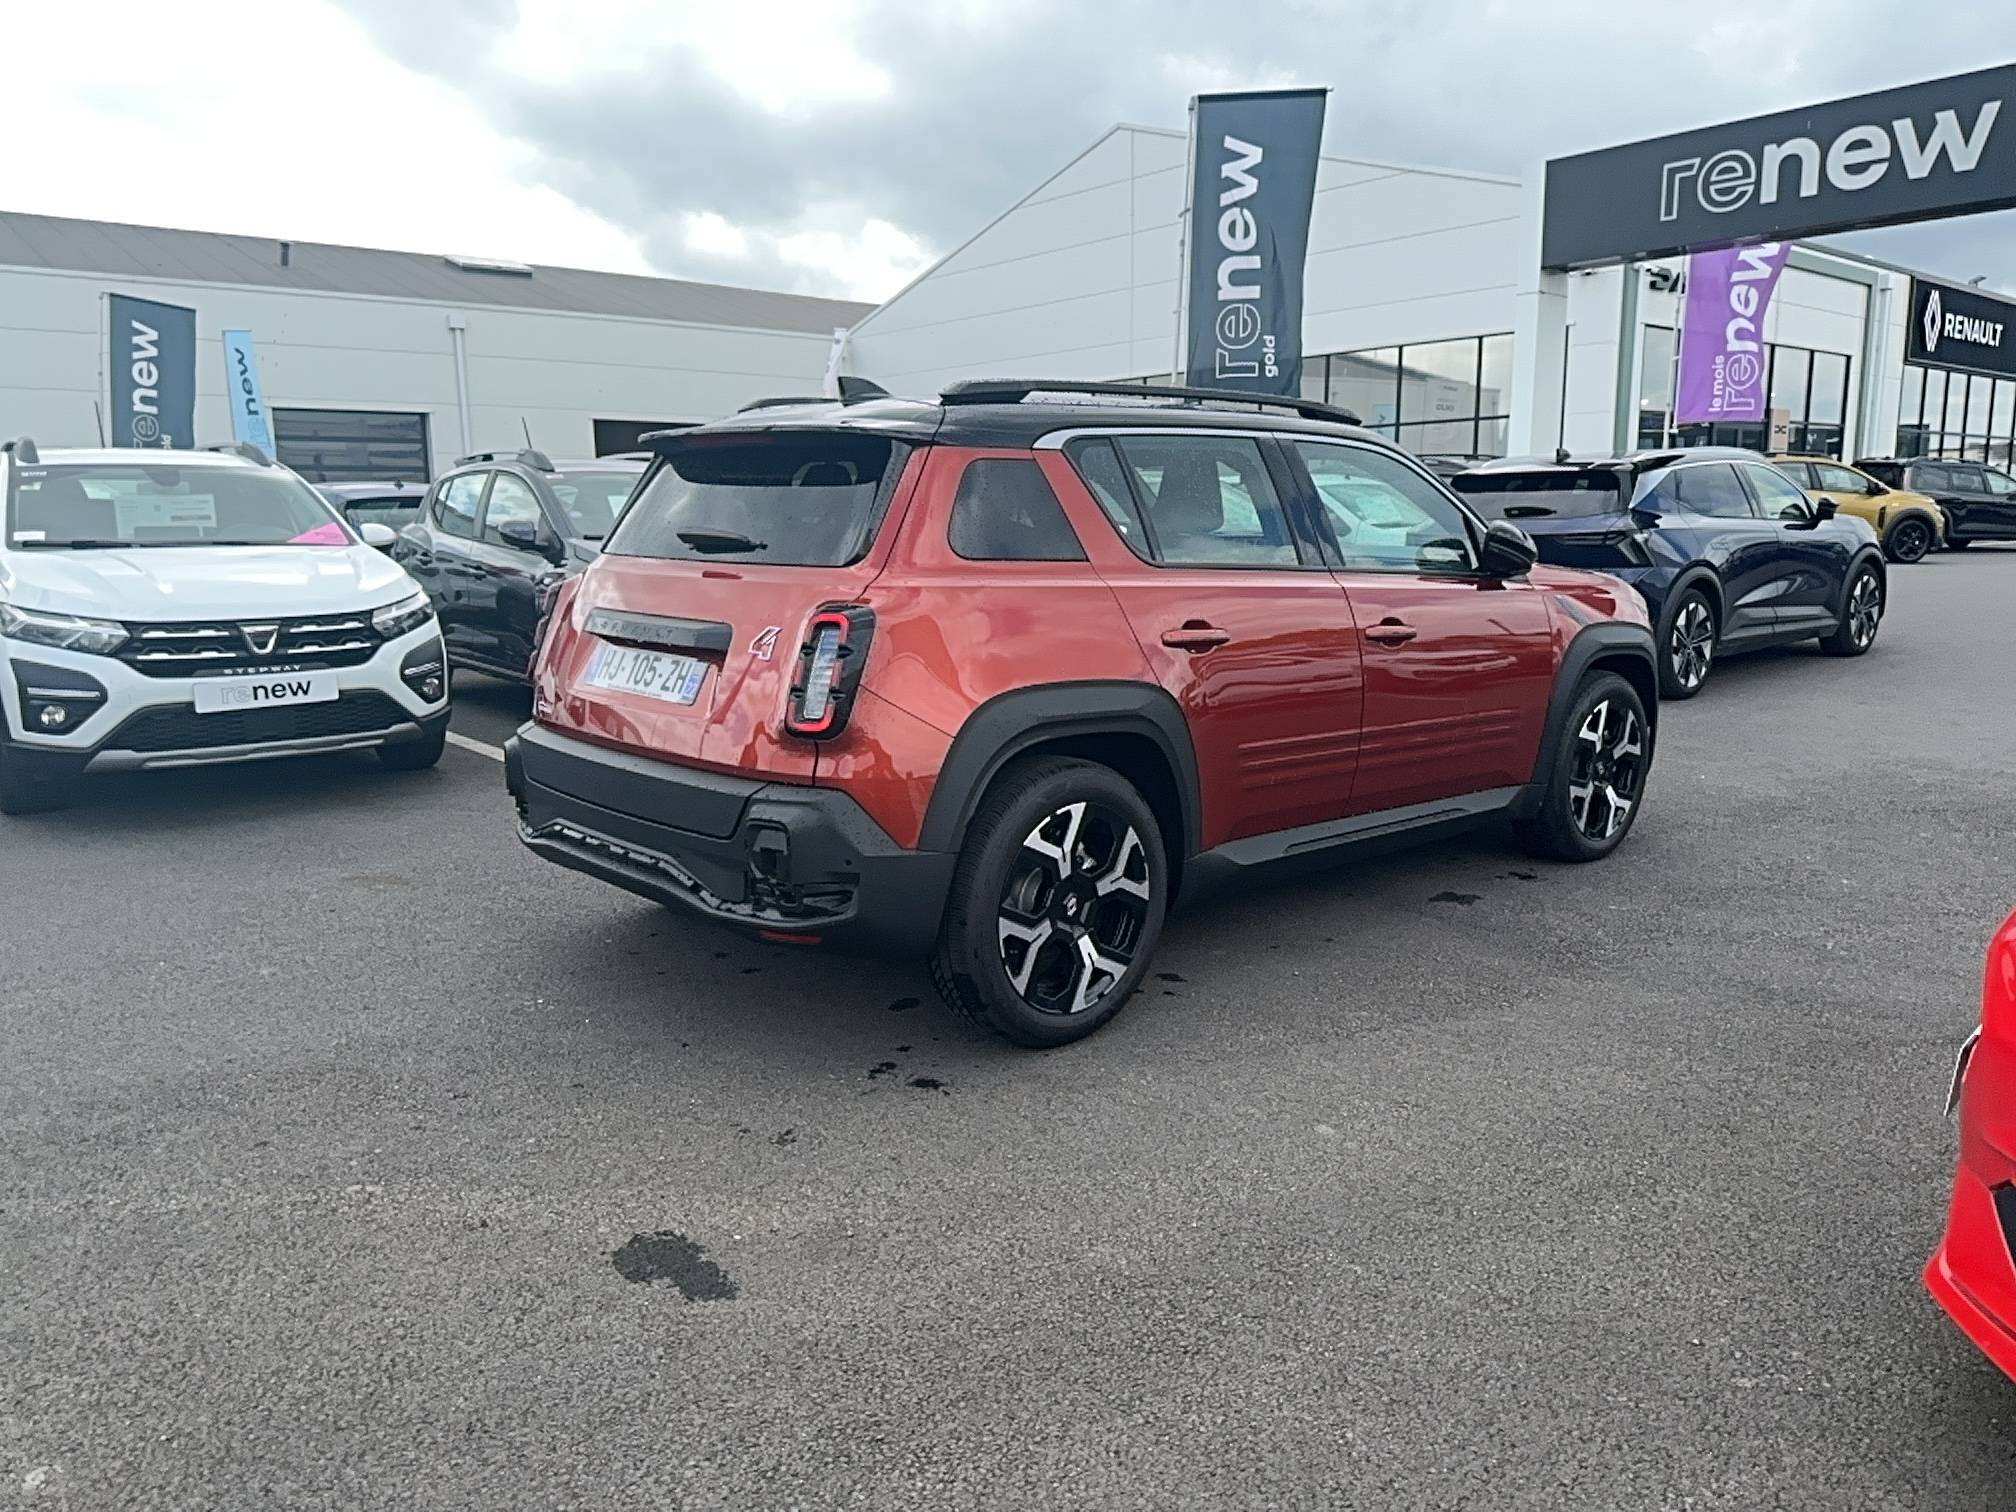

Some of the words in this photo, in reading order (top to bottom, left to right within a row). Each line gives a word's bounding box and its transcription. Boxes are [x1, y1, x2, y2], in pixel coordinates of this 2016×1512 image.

[1660, 99, 2002, 222] renew
[1215, 135, 1263, 379] renew
[1943, 312, 2003, 347] RENAULT
[1262, 334, 1279, 378] gold
[1711, 355, 1725, 395] mois
[1708, 397, 1722, 411] le
[221, 680, 311, 704] renew
